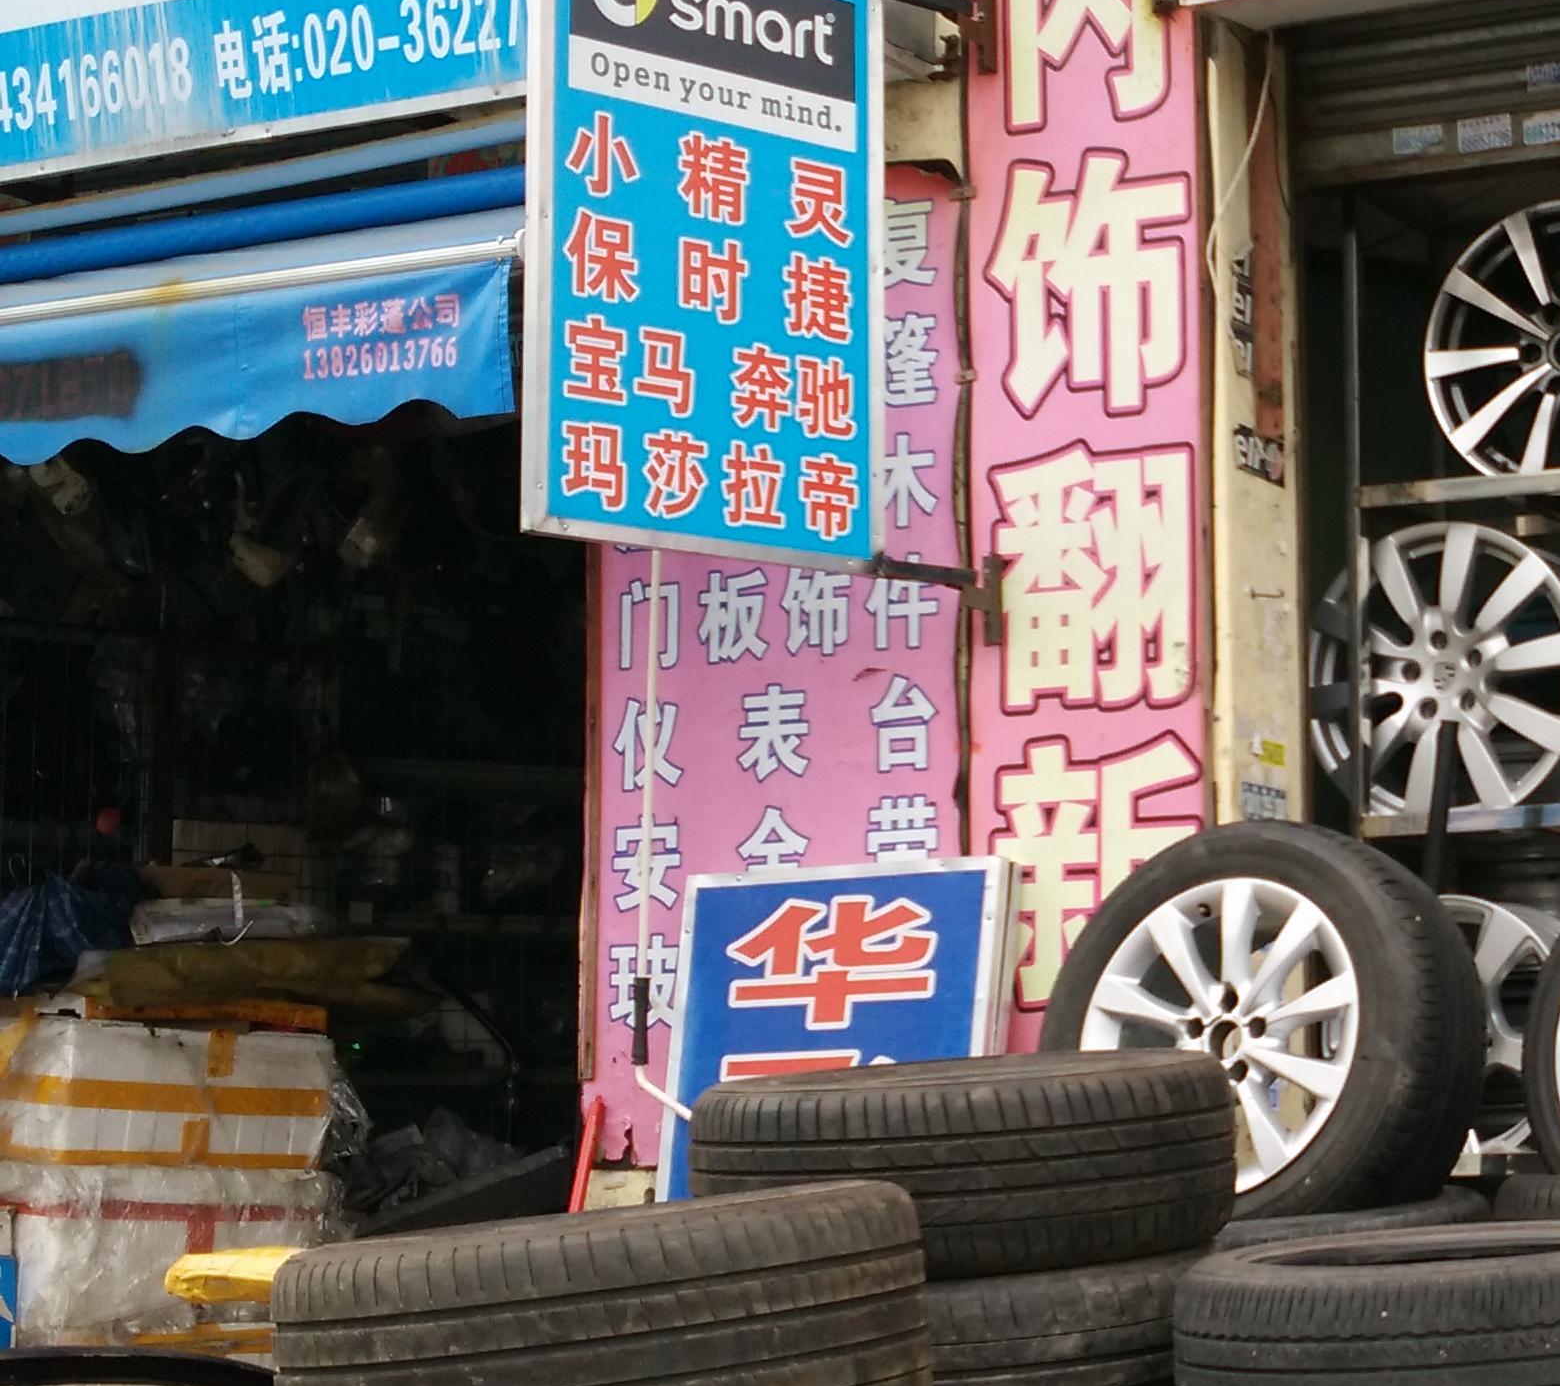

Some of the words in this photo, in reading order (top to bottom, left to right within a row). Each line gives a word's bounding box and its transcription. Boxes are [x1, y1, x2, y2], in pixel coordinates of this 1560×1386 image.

[590, 51, 671, 92] Open
[680, 73, 752, 110] your
[761, 95, 843, 134] mind.
[565, 111, 852, 247] 小精灵
[563, 210, 851, 342] 保时捷
[303, 336, 457, 380] 13826013766
[564, 315, 695, 417] 宝马
[732, 343, 857, 440] 奔驰
[562, 422, 858, 541] 玛莎拉帝
